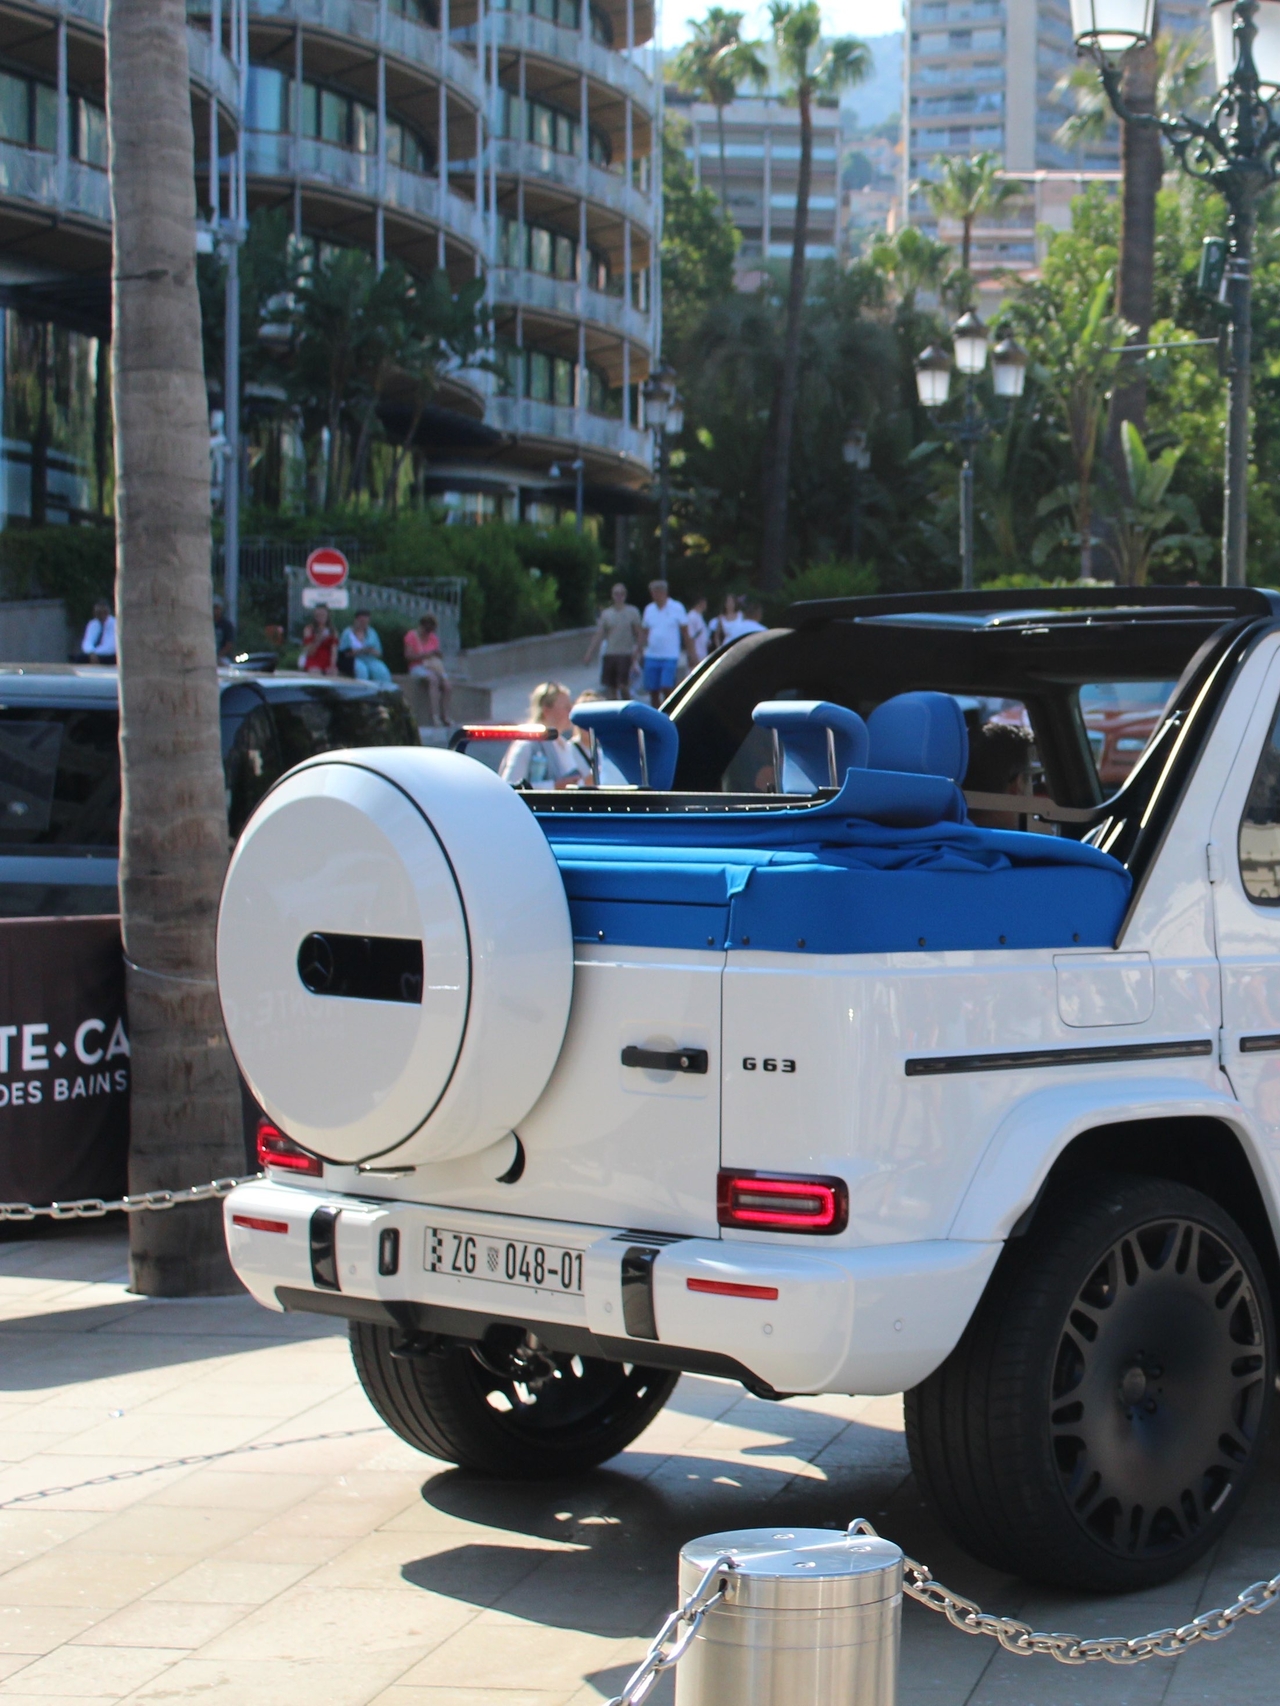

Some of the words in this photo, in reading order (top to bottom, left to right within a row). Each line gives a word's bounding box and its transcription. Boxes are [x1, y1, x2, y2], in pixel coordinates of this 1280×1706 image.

[54, 1069, 127, 1101] BAINS
[452, 1234, 476, 1274] ZG
[505, 1242, 583, 1292] 048-01
